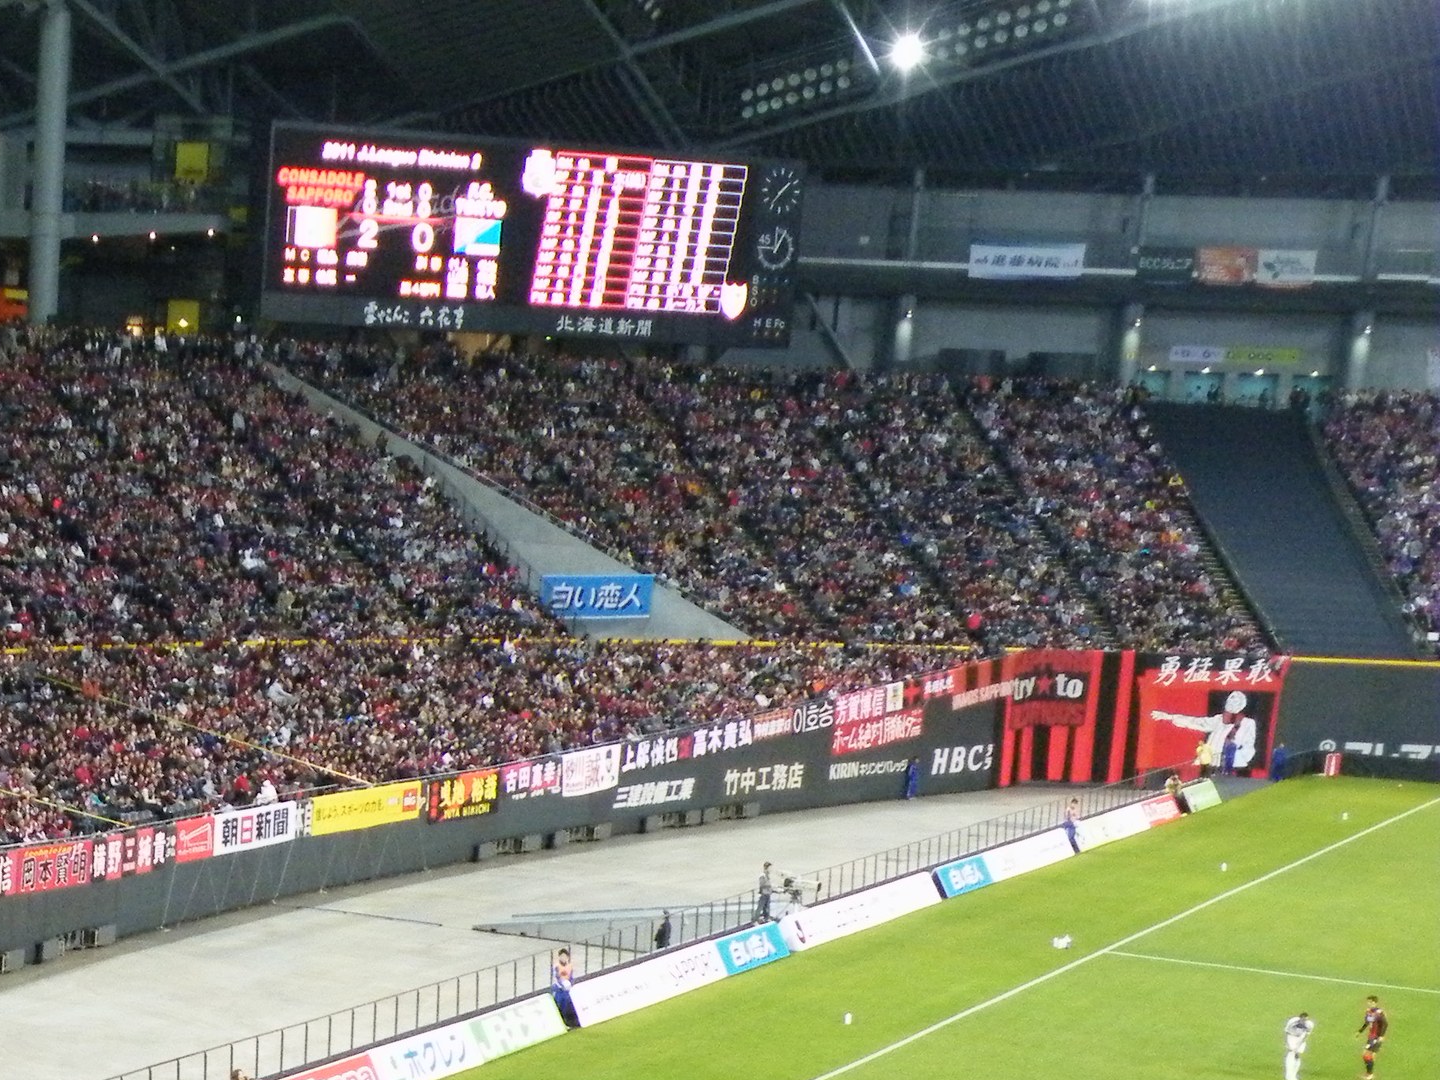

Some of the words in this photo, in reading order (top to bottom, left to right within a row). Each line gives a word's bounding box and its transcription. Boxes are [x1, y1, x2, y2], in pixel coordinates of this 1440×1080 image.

[278, 168, 364, 187] CONSADOLE
[287, 186, 355, 206] SAPPORO
[357, 218, 379, 249] 2
[412, 222, 435, 253] 0
[556, 315, 653, 337] 北海道新聞
[552, 582, 642, 609] 白い恋人
[1054, 673, 1084, 699] to
[1152, 655, 1274, 687] 勇猛果敢
[793, 701, 834, 733] 이호승
[693, 719, 753, 758] 高木貴弘
[828, 761, 860, 780] KIRIN
[931, 744, 984, 776] HBC
[724, 762, 805, 796] 竹中工務店
[222, 807, 289, 847] 朝日新聞
[20, 848, 88, 892] 岡本賢明
[402, 1033, 467, 1080] ホクレン
